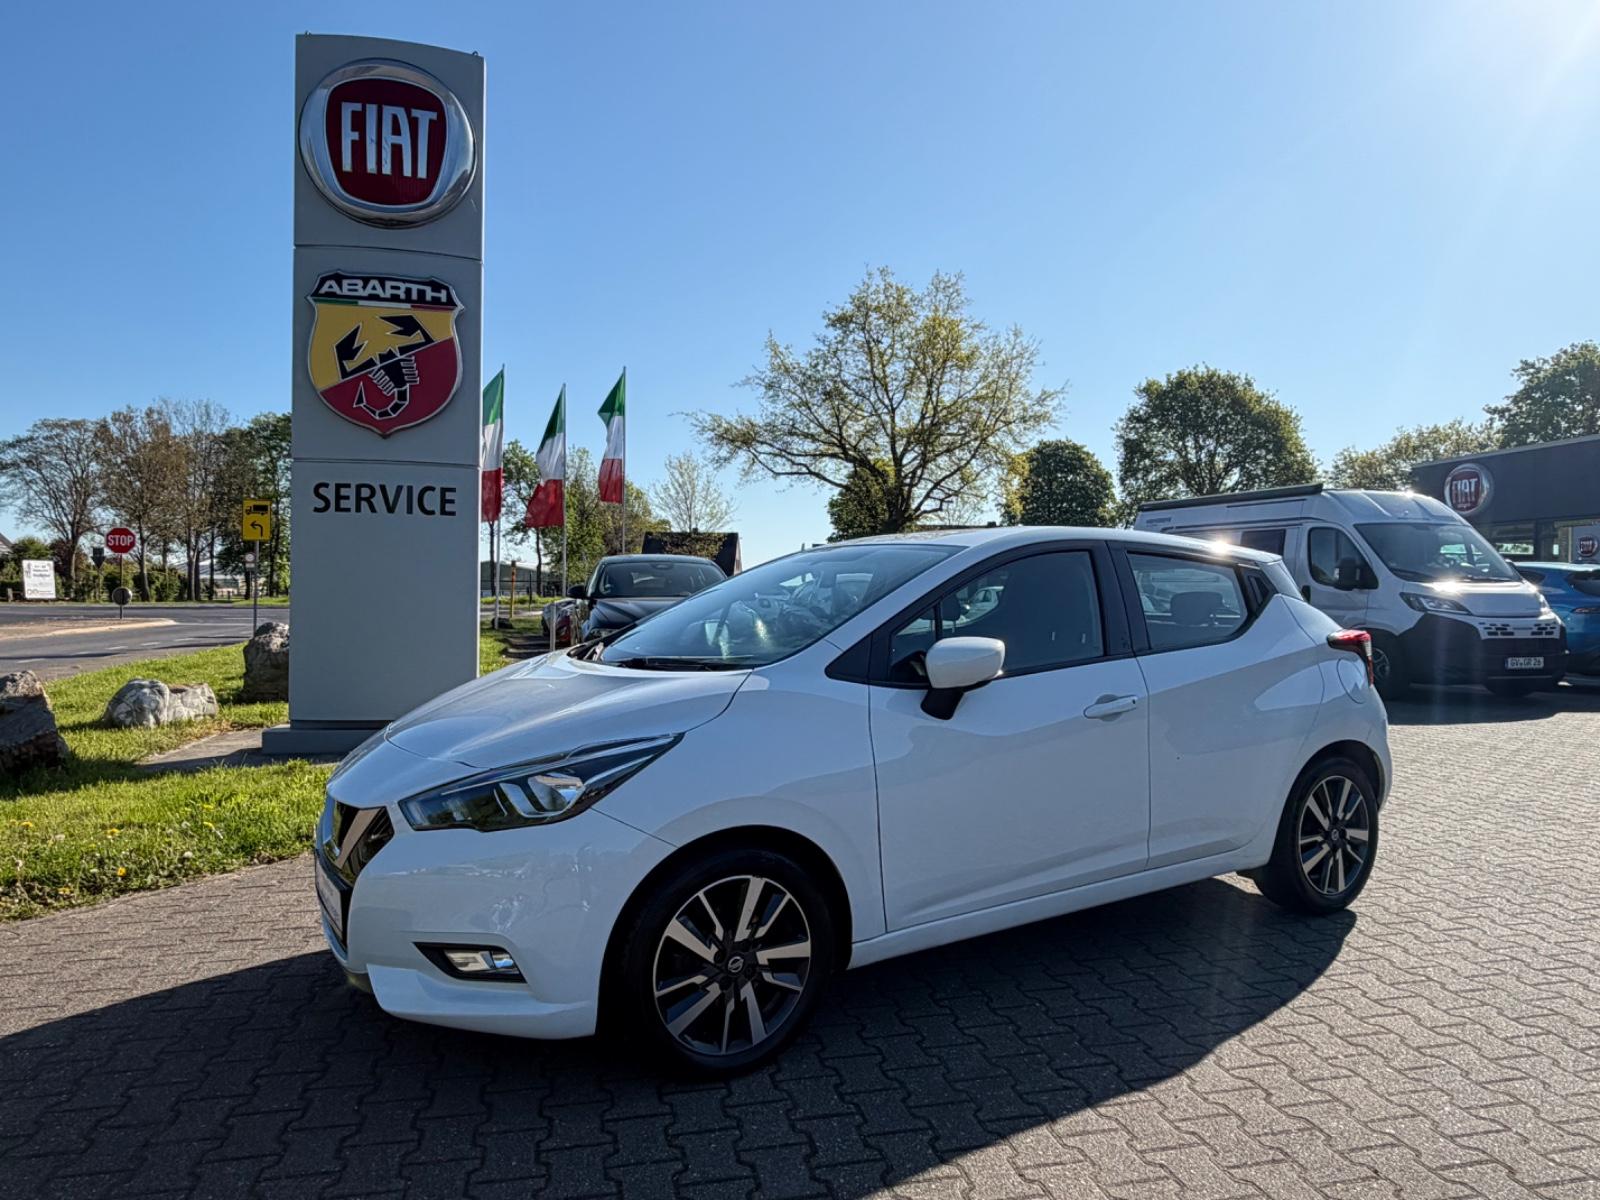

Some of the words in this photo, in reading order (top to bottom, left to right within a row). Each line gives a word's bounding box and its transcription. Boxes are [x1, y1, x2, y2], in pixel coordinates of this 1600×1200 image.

[341, 101, 437, 179] FIAT
[318, 279, 447, 303] ABARTH
[313, 482, 457, 517] SERVICE
[1452, 478, 1478, 503] FIAT
[107, 534, 134, 546] STOP
